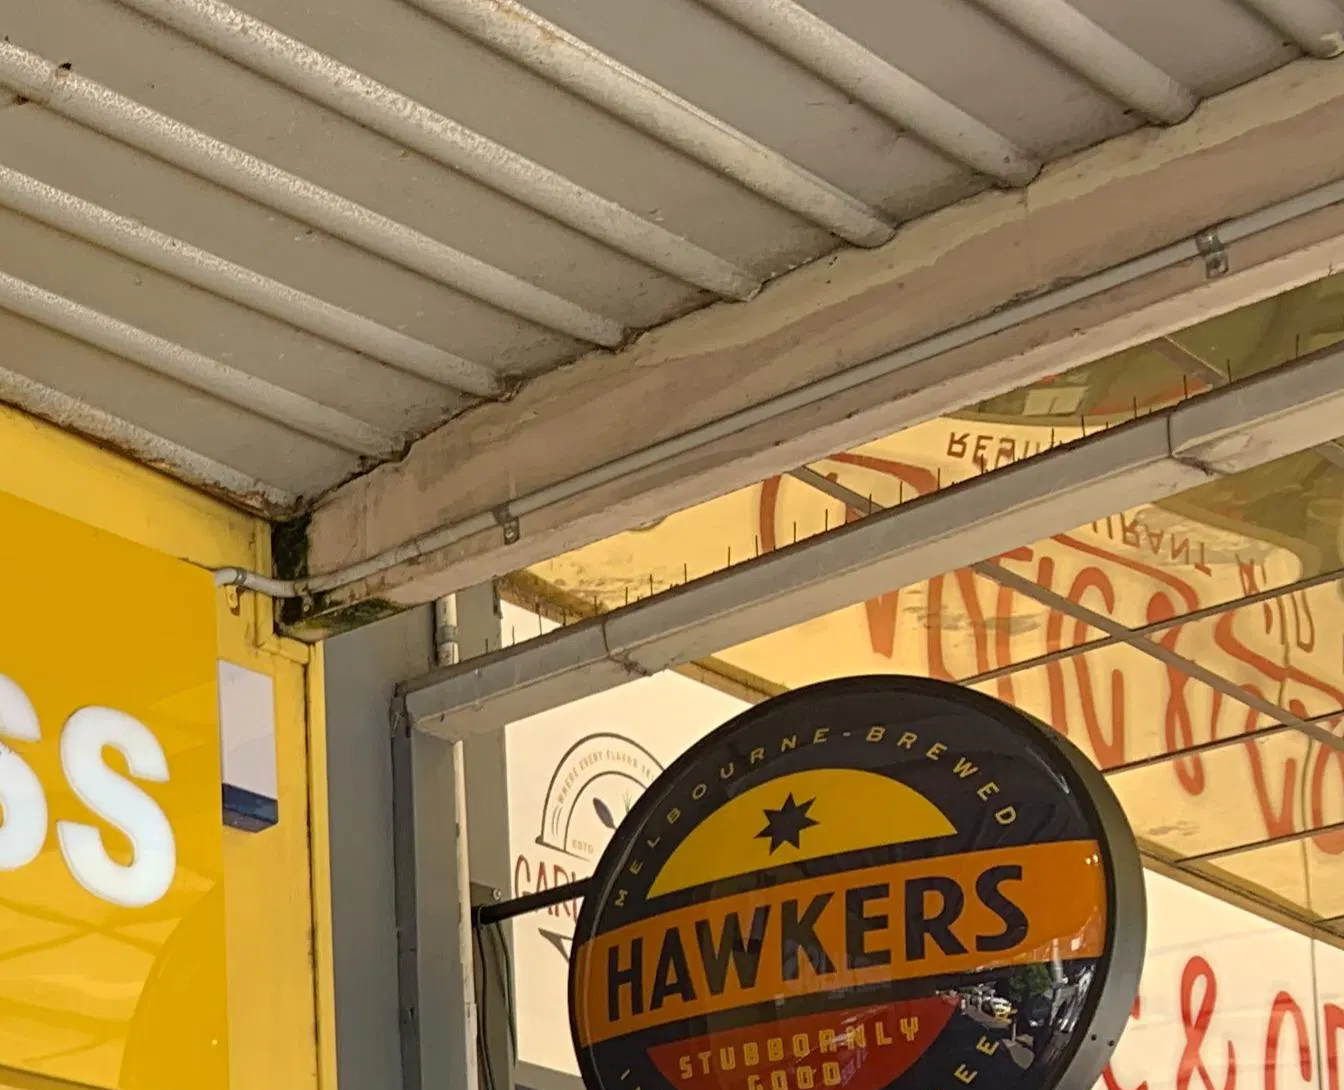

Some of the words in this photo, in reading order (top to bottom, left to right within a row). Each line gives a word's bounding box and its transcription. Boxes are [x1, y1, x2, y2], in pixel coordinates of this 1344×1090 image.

[579, 750, 603, 772] EVERY
[615, 725, 1018, 906] MELBOURNE-BREWED
[607, 865, 1029, 1022] HAWKERS
[680, 1016, 919, 1080] STUBBORNLY
